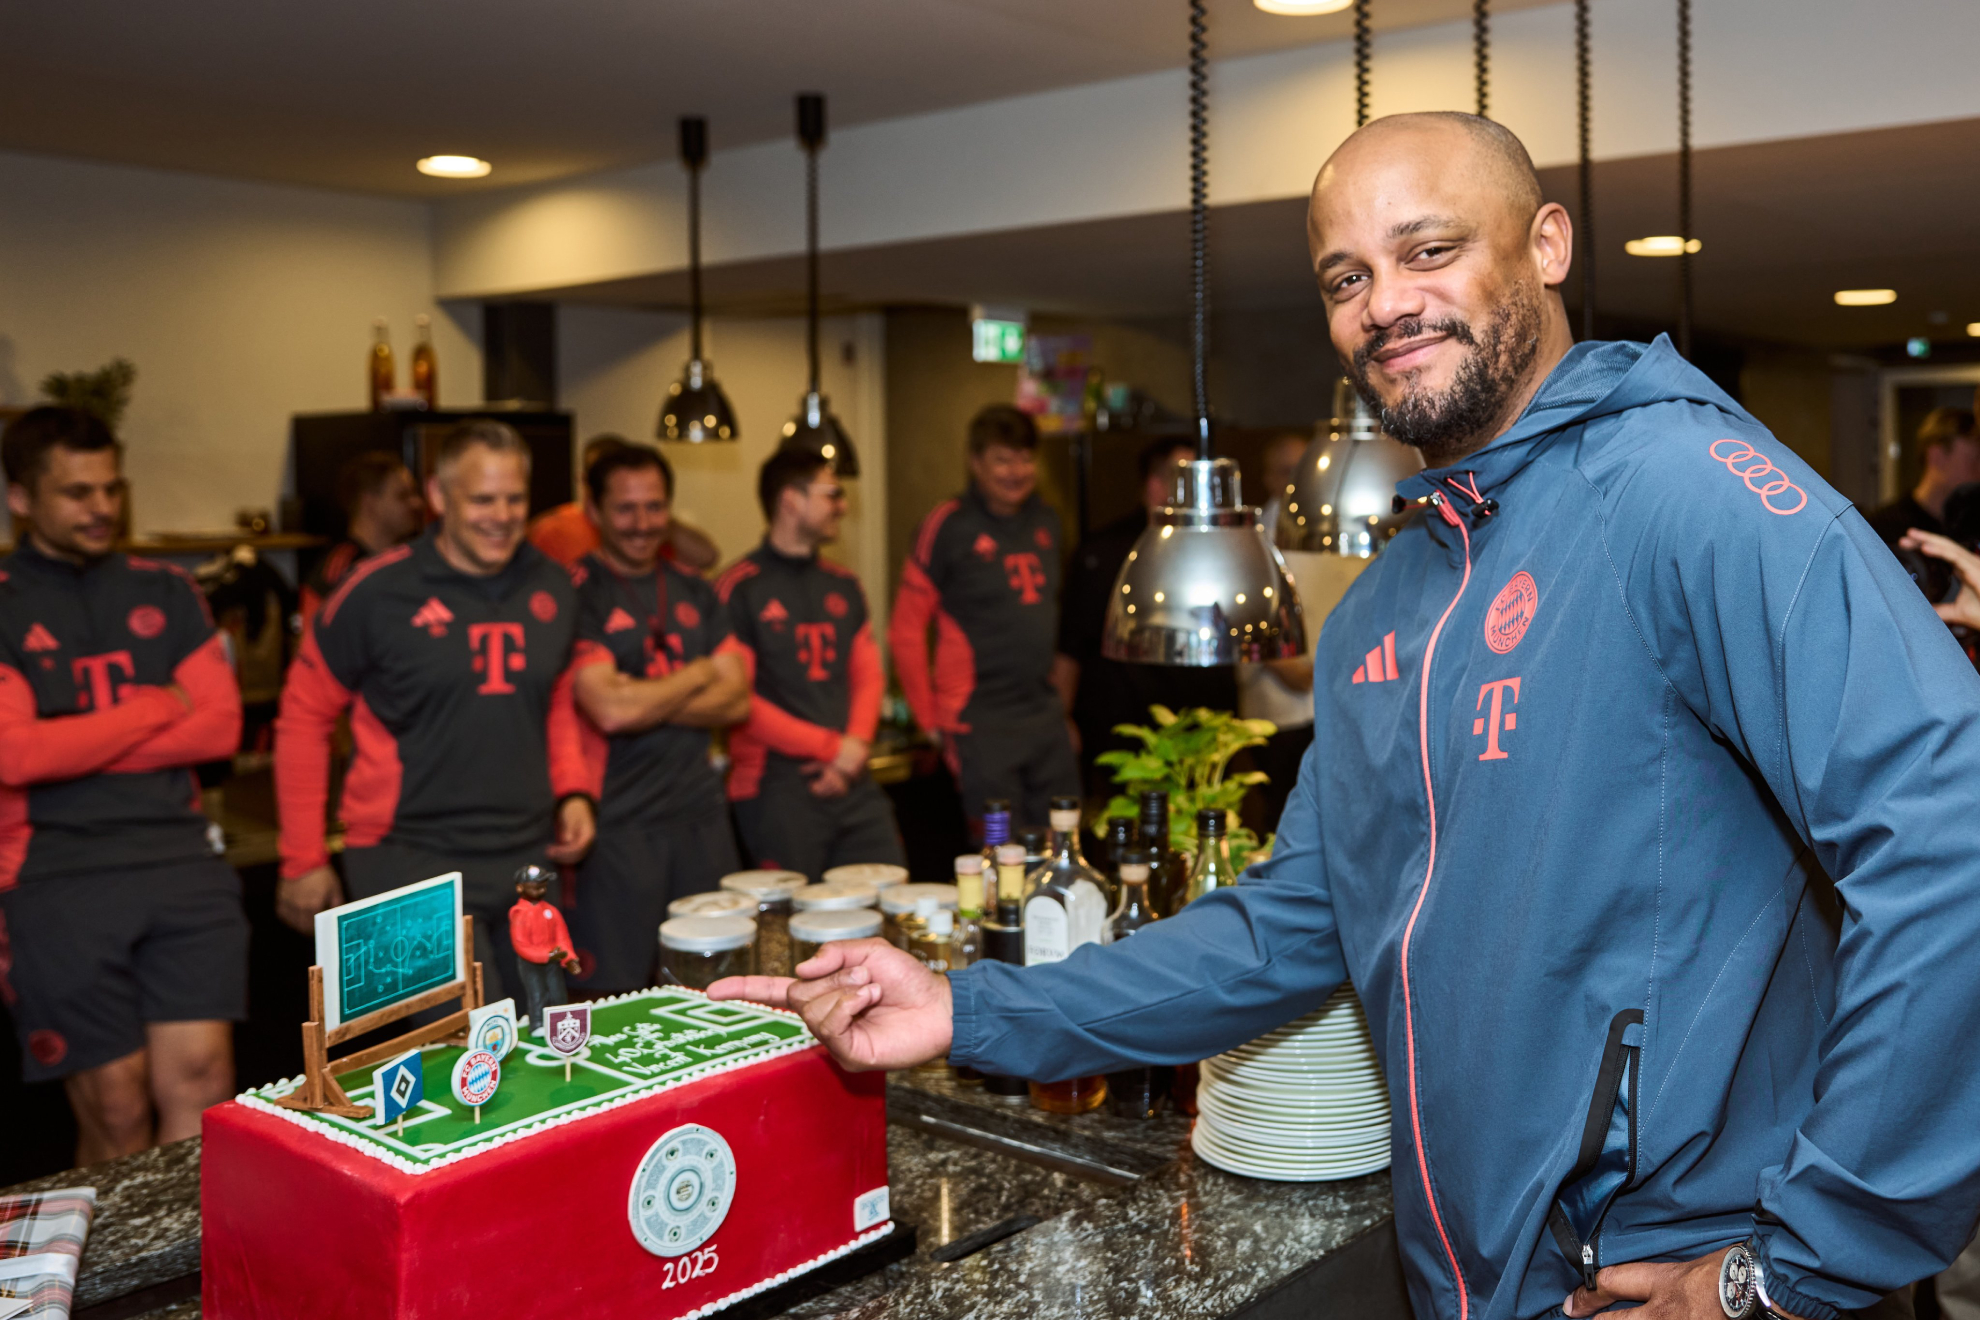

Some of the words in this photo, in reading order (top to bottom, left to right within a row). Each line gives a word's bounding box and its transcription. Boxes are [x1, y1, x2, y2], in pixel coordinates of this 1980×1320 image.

[1004, 552, 1046, 605] T
[1510, 578, 1533, 603] BAYERN
[467, 622, 527, 695] T
[795, 622, 837, 682] T
[1473, 677, 1521, 761] T
[470, 1052, 499, 1072] BAYERN
[685, 1031, 781, 1057] Kompany
[661, 1244, 720, 1290] 2025
